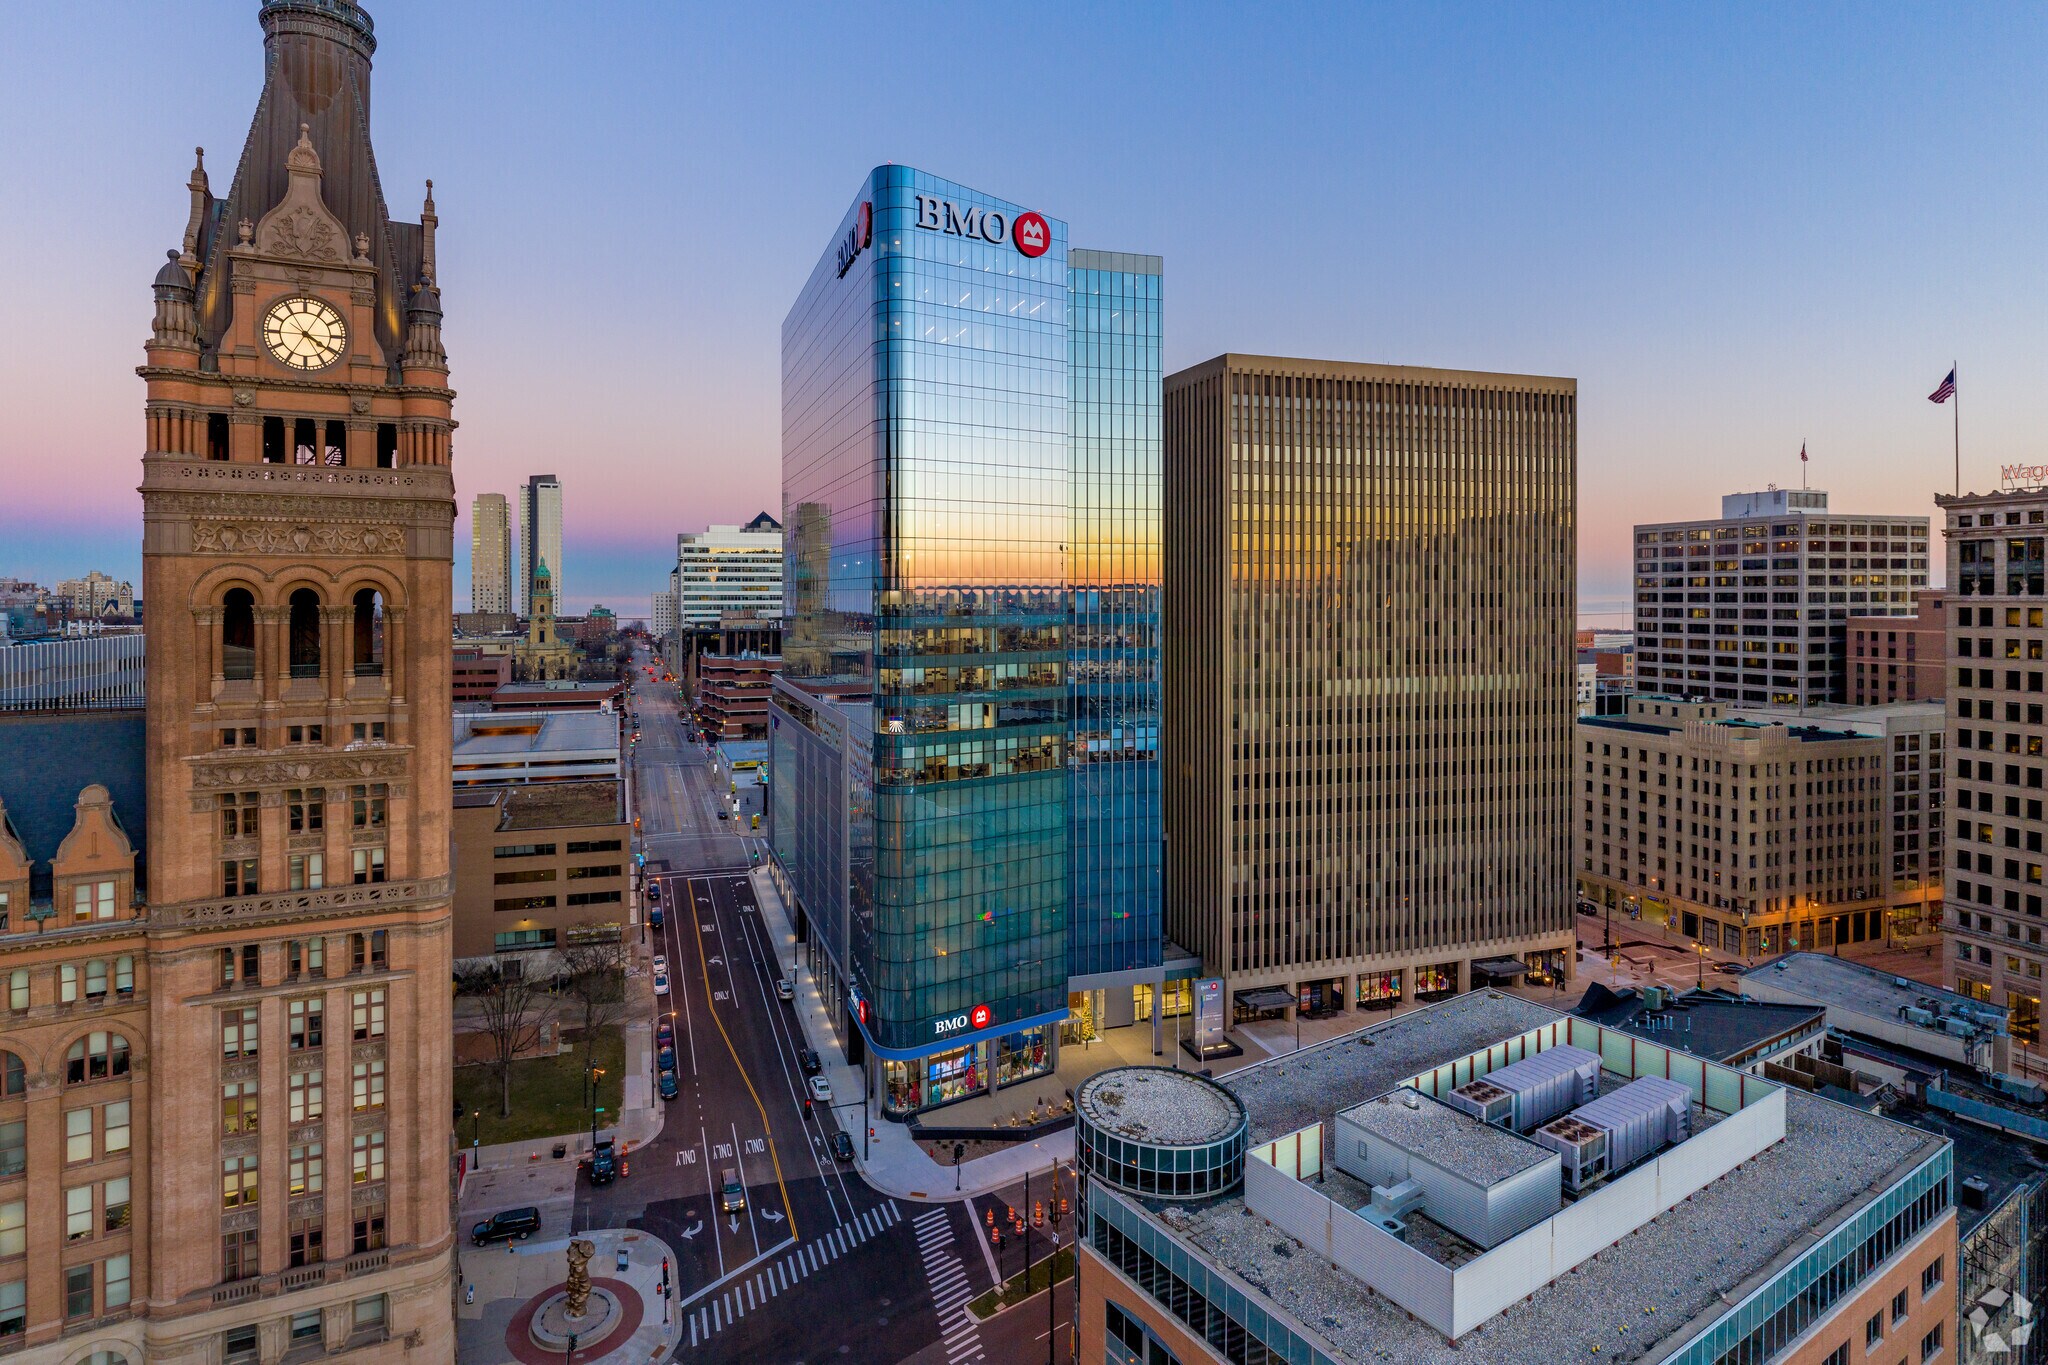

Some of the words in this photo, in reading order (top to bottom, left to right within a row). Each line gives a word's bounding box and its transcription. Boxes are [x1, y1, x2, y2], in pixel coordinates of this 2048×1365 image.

[916, 194, 1011, 244] BMO
[742, 904, 755, 913] ONLY
[701, 923, 715, 932] ONLY
[714, 990, 729, 1001] ONLY
[934, 1015, 968, 1034] BMO
[712, 1143, 733, 1160] ONLY
[744, 1138, 765, 1155] ONLY
[675, 1149, 697, 1167] ONLY
